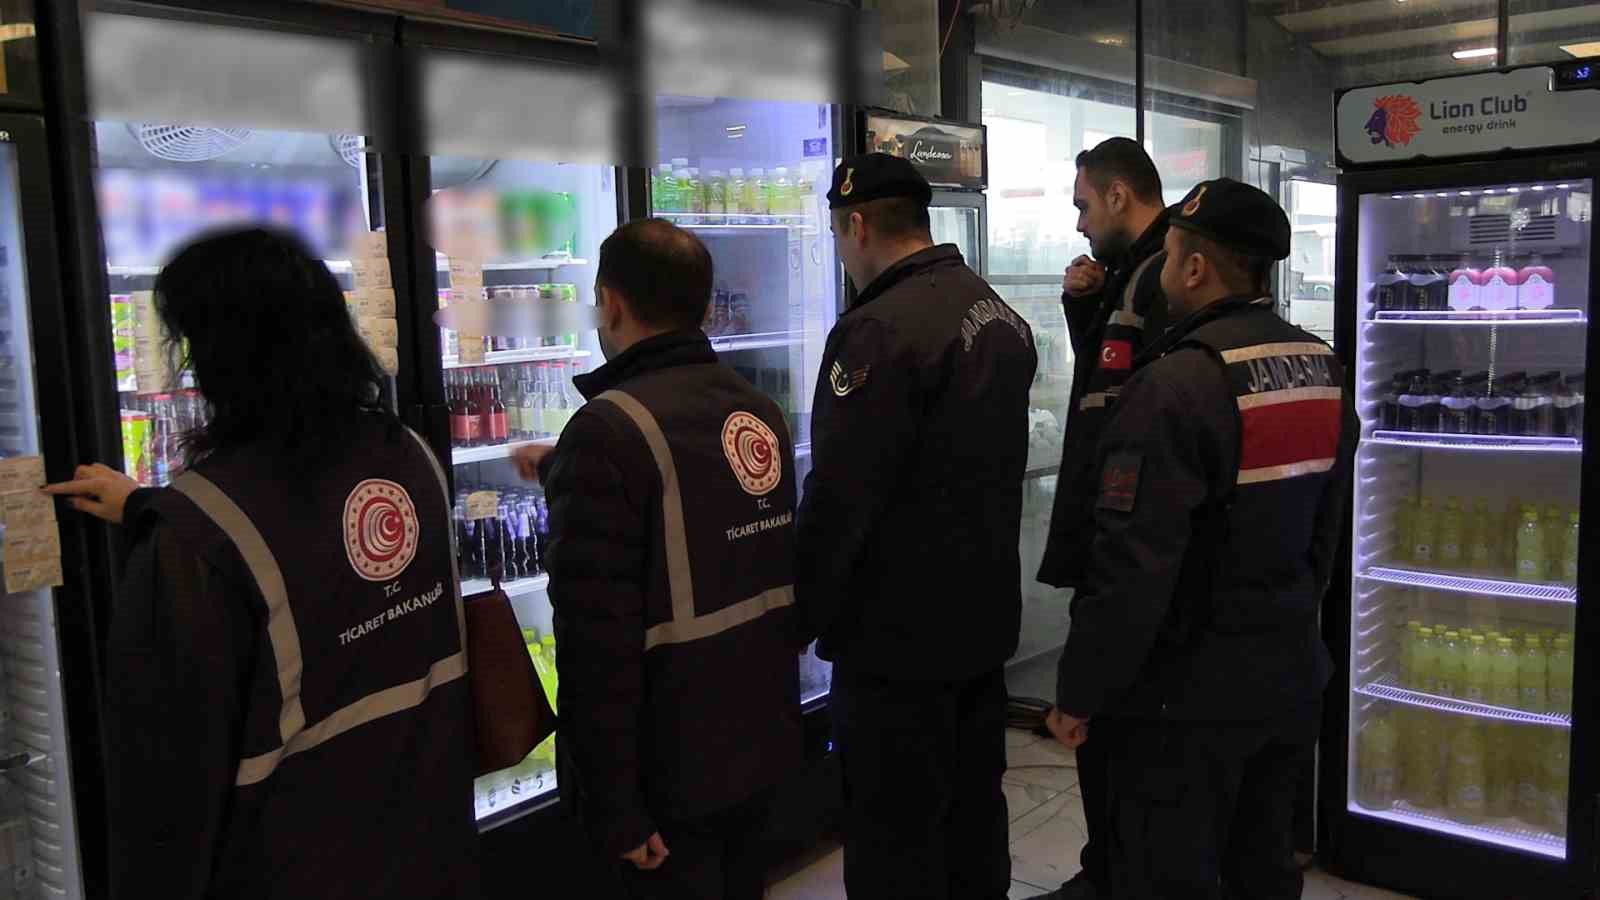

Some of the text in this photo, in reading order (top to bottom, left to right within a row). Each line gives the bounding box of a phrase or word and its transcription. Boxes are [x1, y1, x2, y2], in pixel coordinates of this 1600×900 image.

[1430, 94, 1527, 120] Lion Club
[1442, 118, 1516, 135] energy drink
[338, 611, 387, 645] TİCARET
